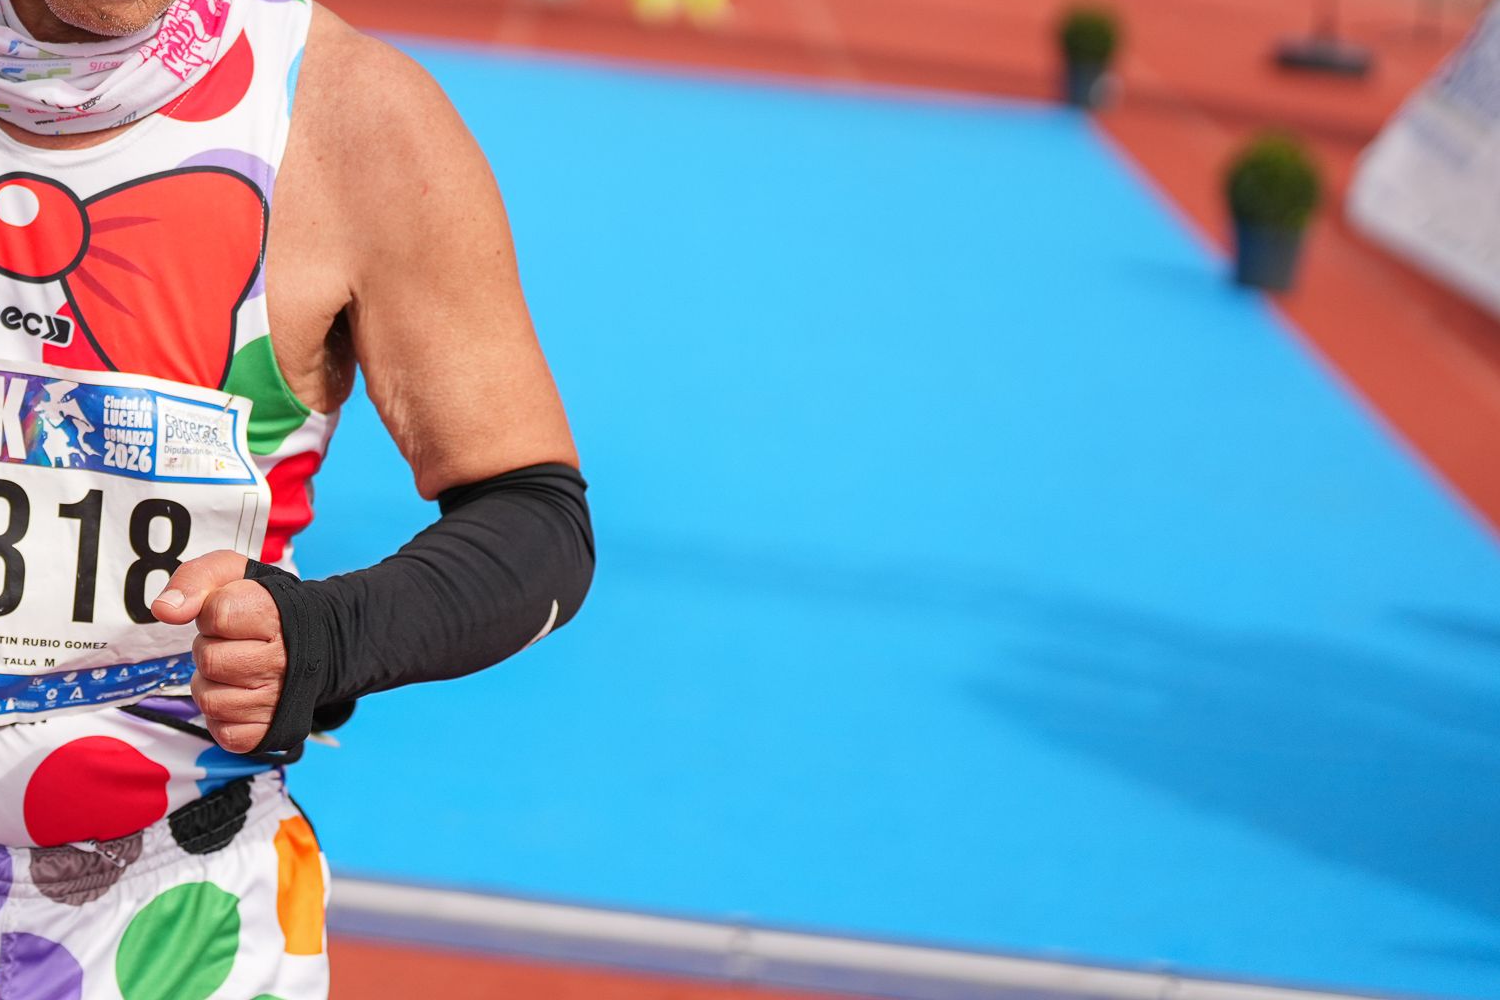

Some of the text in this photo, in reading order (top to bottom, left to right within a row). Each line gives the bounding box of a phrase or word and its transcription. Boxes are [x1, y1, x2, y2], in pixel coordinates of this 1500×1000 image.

[103, 394, 153, 412] Ciudad de
[103, 407, 153, 429] LUCENA
[164, 413, 218, 441] carreras
[103, 440, 153, 473] 2026
[22, 637, 61, 648] RUBIO
[64, 640, 109, 650] GOMEZ
[3, 657, 56, 668] TALLA M
